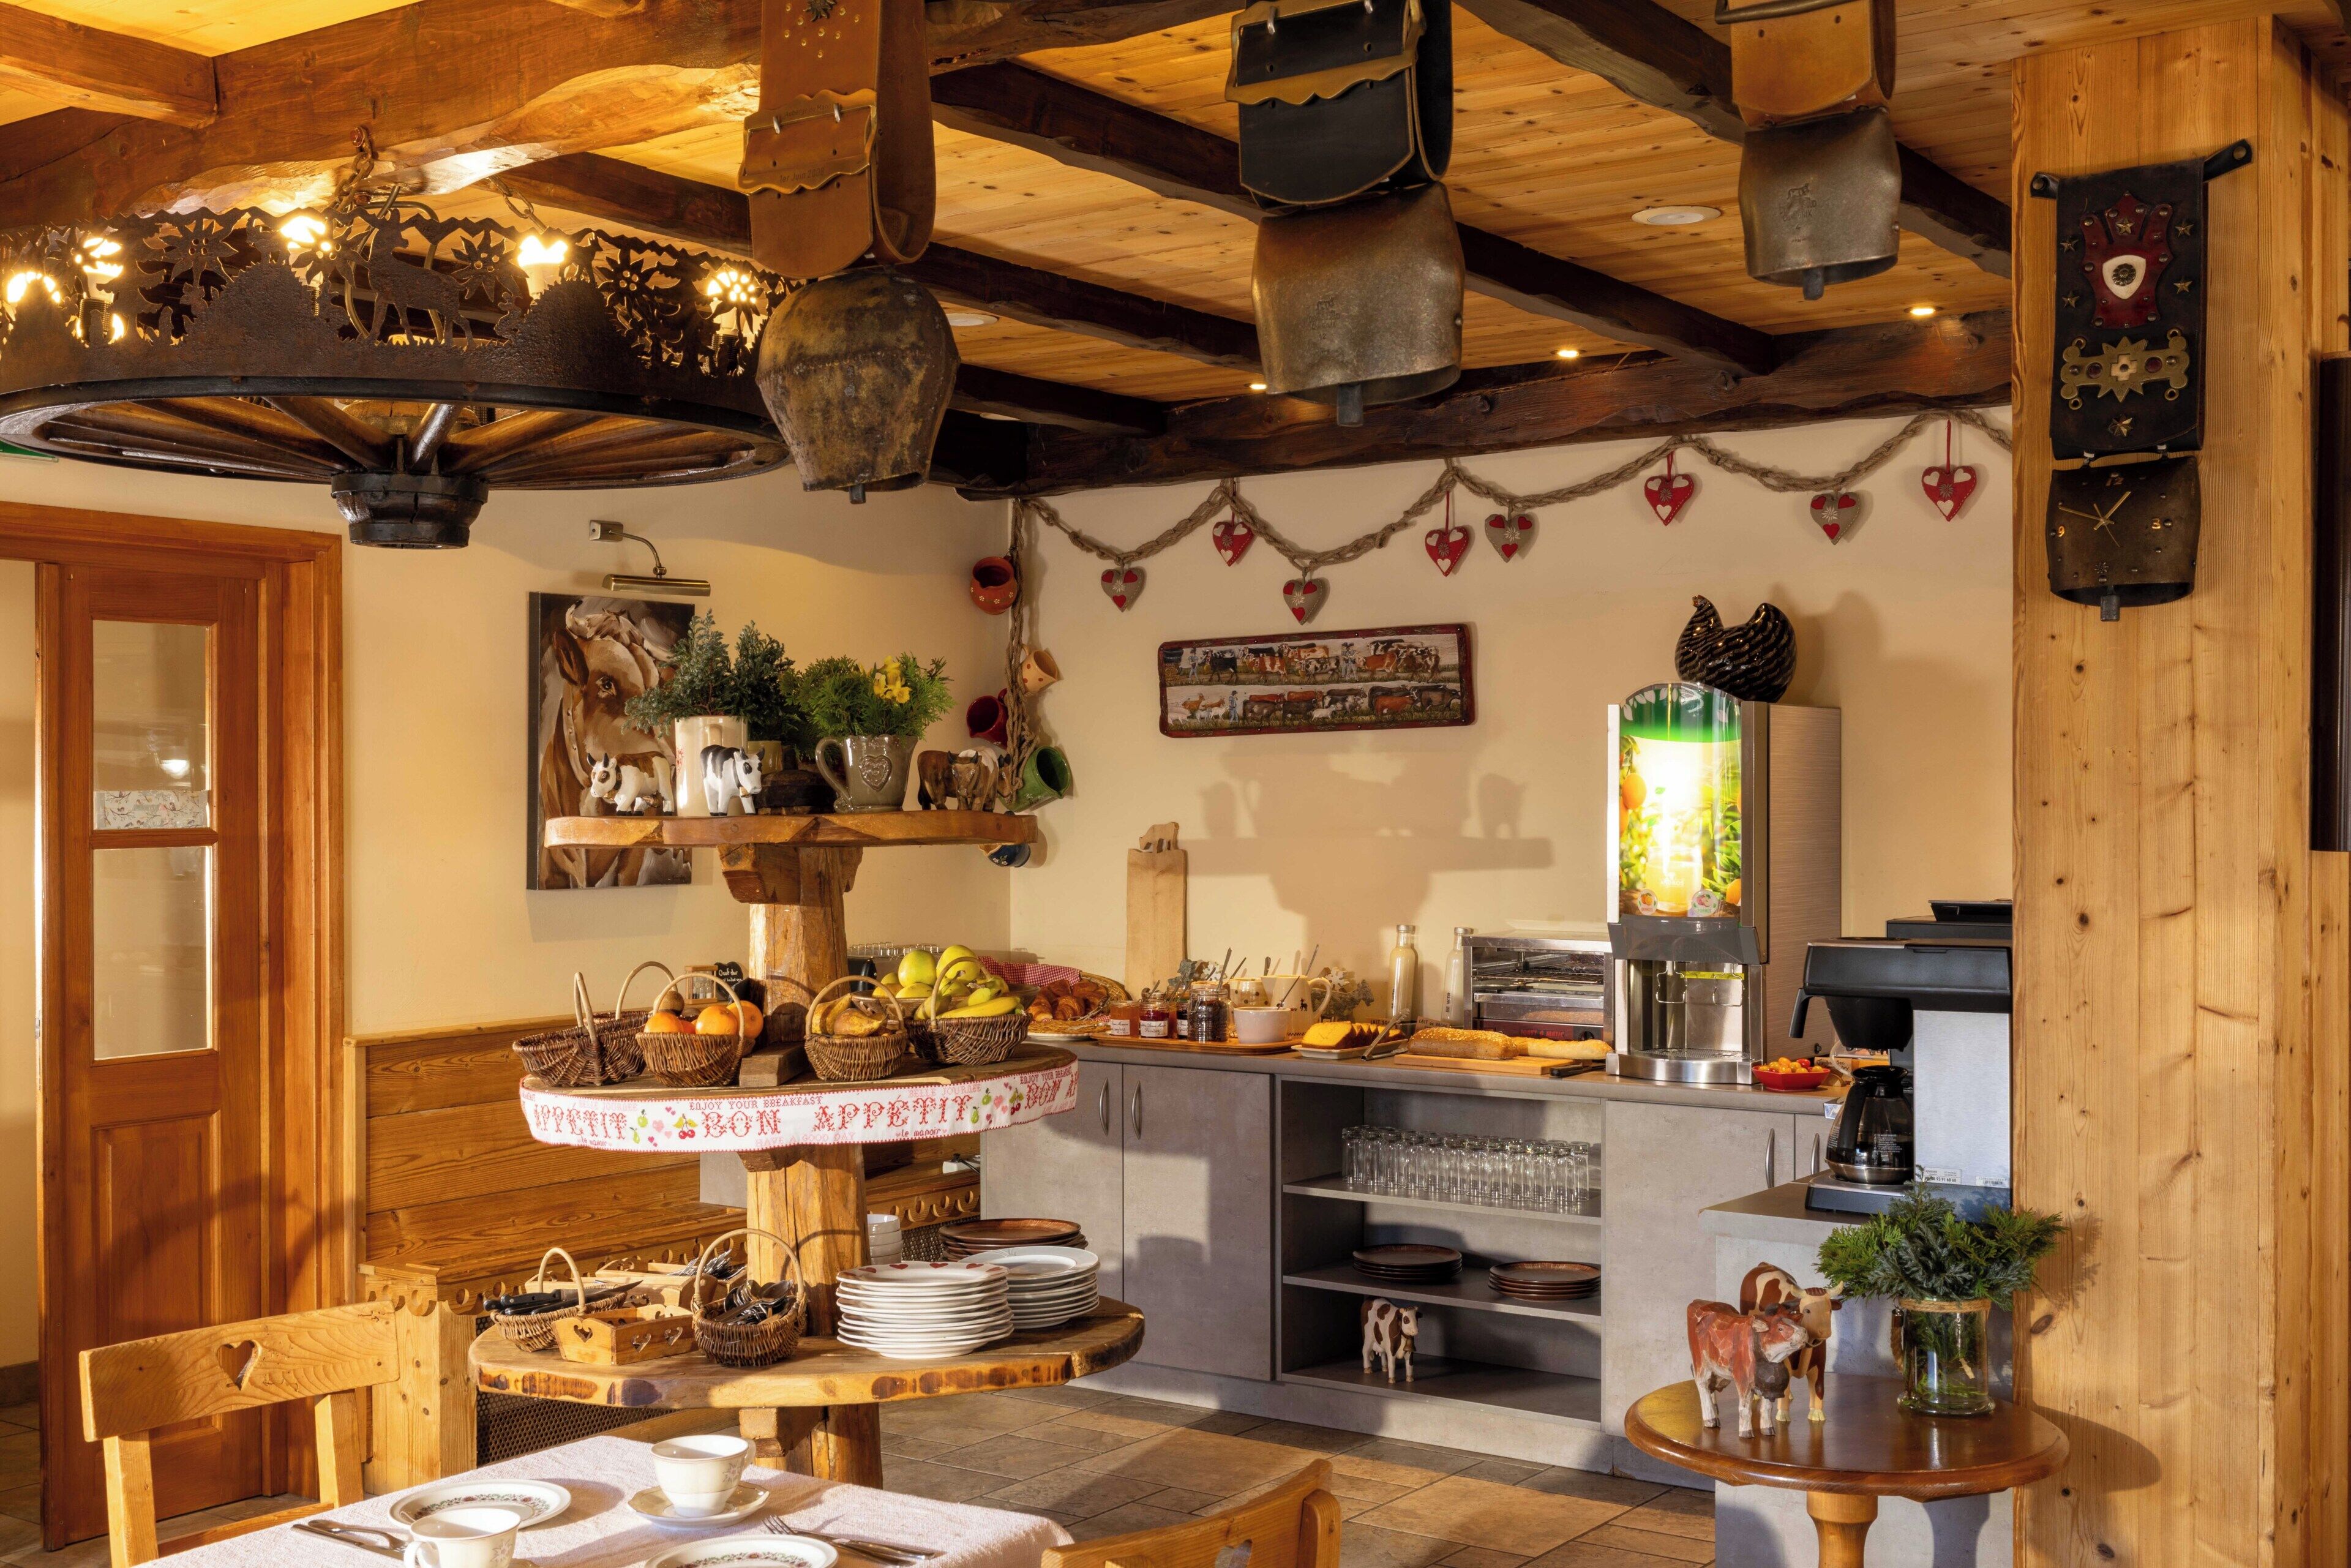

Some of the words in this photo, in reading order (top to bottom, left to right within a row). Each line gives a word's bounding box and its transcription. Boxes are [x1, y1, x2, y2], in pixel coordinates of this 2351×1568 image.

[2105, 476, 2124, 487] 12
[2151, 517, 2161, 530] 3
[2058, 525, 2066, 538] 9
[718, 967, 730, 976] Oeuf
[1020, 1074, 1039, 1084] ENJOY
[1041, 1071, 1054, 1081] YOUR
[1024, 1079, 1062, 1109] BON
[689, 1101, 723, 1111] ENJOY
[728, 1100, 759, 1109] YOUR
[763, 1095, 823, 1108] BREAKFAST
[812, 1094, 973, 1132] APPÉTIT
[702, 1108, 782, 1138] BON
[789, 1135, 797, 1144] A
[802, 1134, 829, 1142] GOOD
[833, 1131, 856, 1141] DAY
[901, 1128, 909, 1138] le
[913, 1127, 941, 1137] manoir
